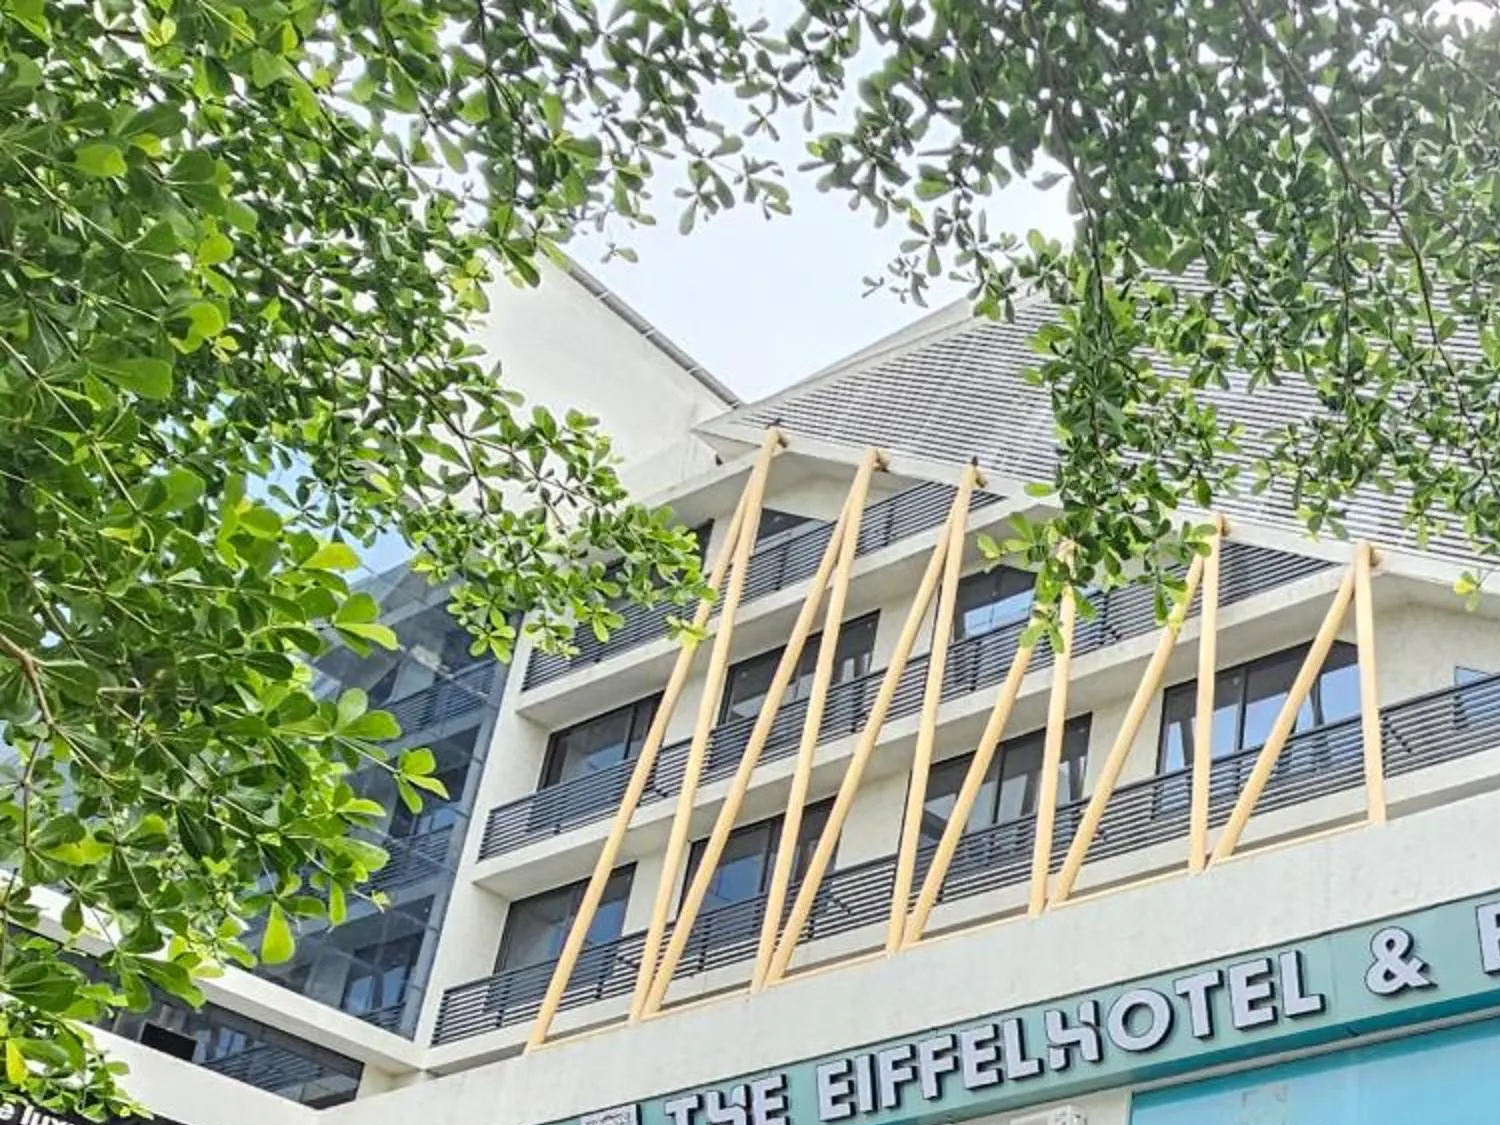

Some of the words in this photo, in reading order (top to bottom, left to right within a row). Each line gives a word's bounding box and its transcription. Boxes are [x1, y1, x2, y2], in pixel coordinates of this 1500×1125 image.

[816, 1016, 1042, 1123] EIFFEL
[1044, 949, 1325, 1071] HOTEL
[1364, 926, 1436, 998] &
